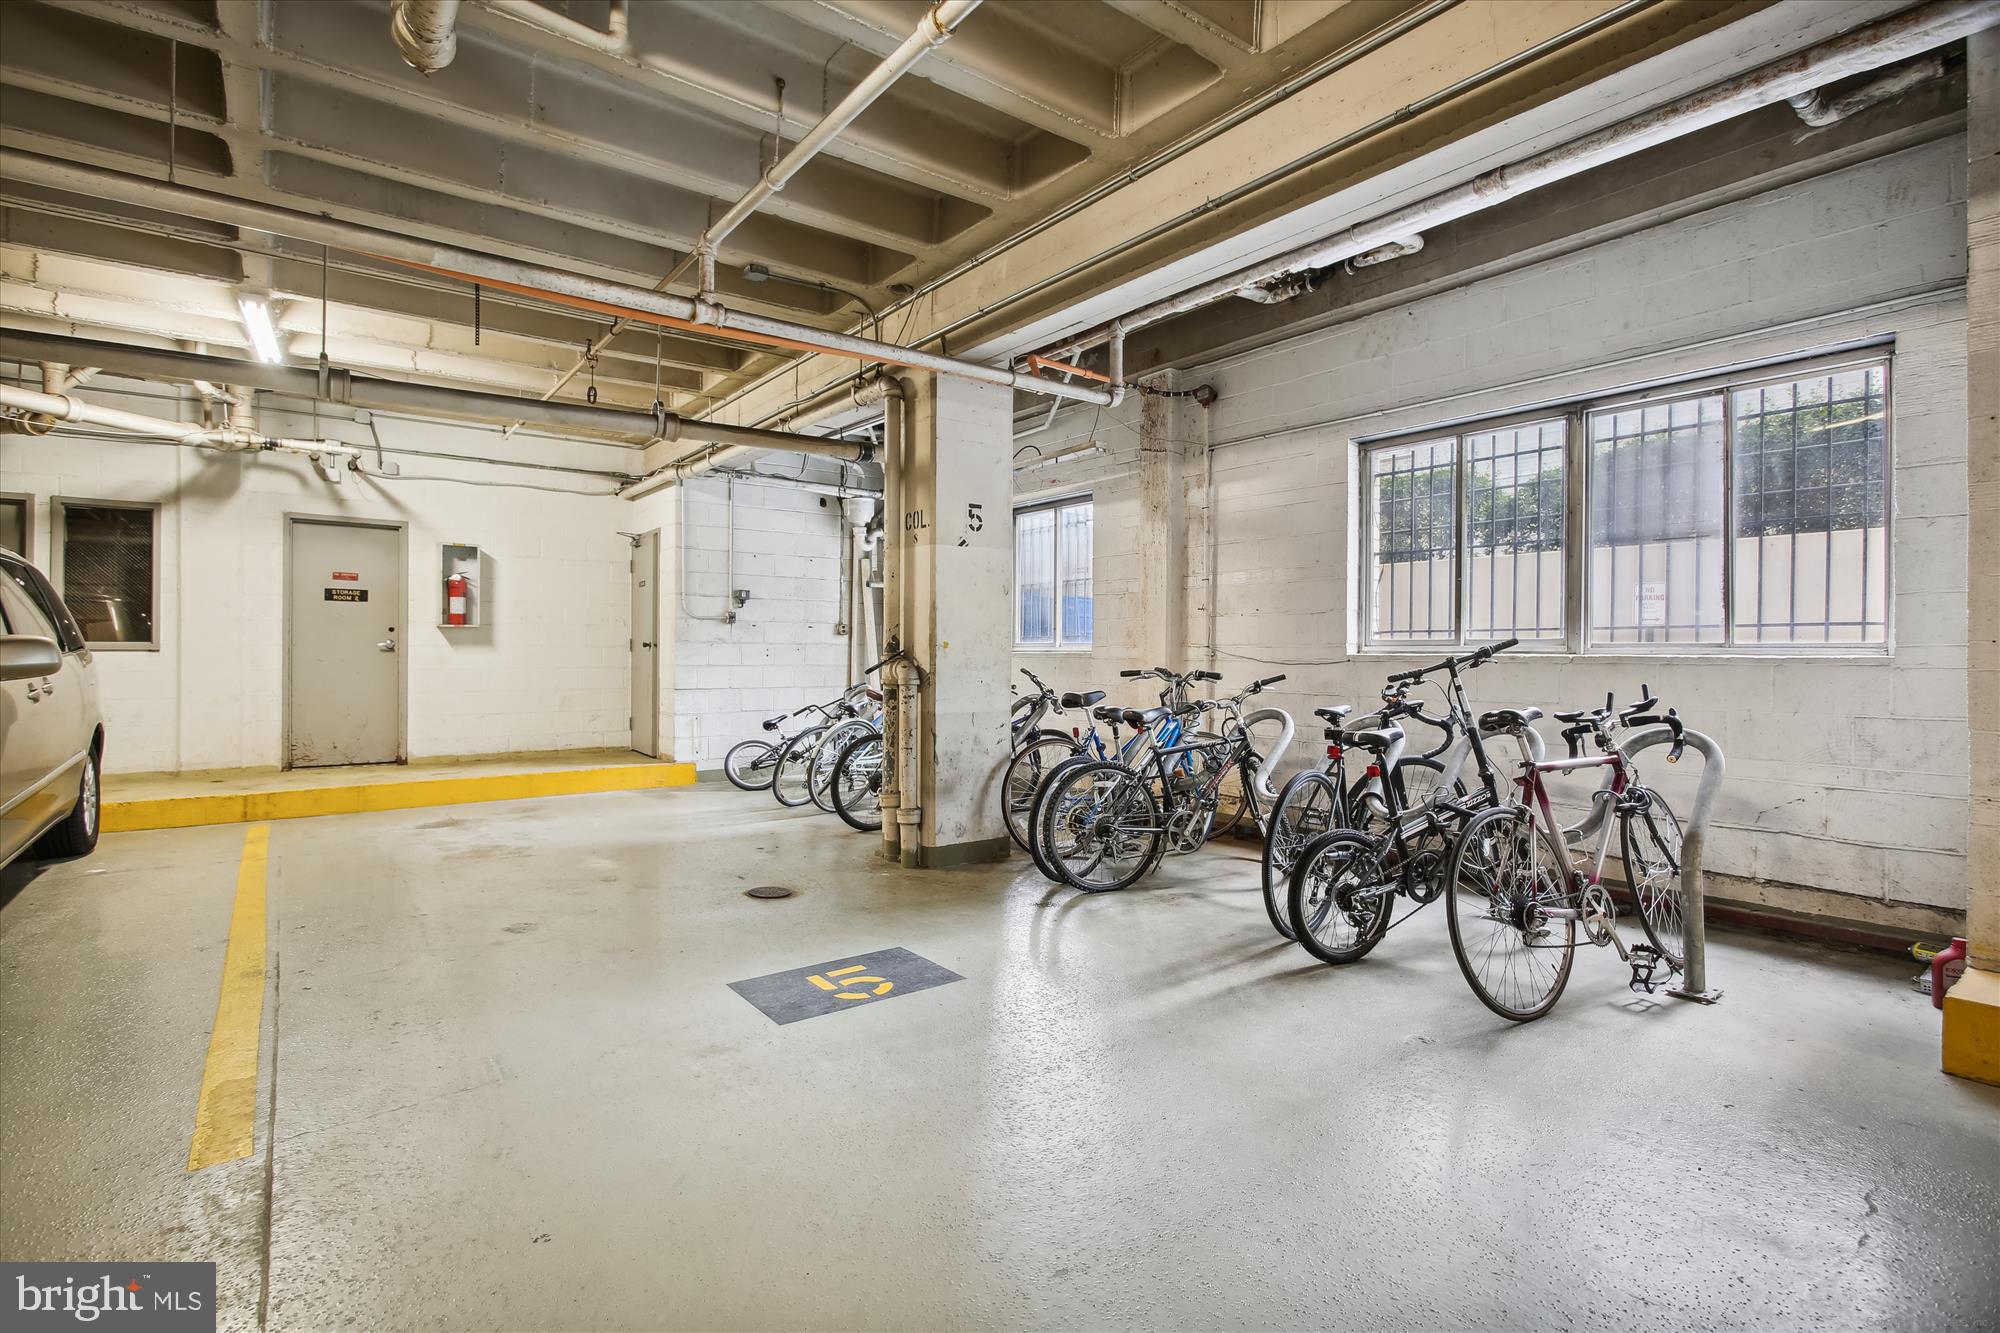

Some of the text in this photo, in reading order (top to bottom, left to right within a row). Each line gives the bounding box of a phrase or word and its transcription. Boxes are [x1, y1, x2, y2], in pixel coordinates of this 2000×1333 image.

[905, 509, 930, 531] COL.
[968, 503, 983, 532] 5
[806, 965, 894, 1000] 5
